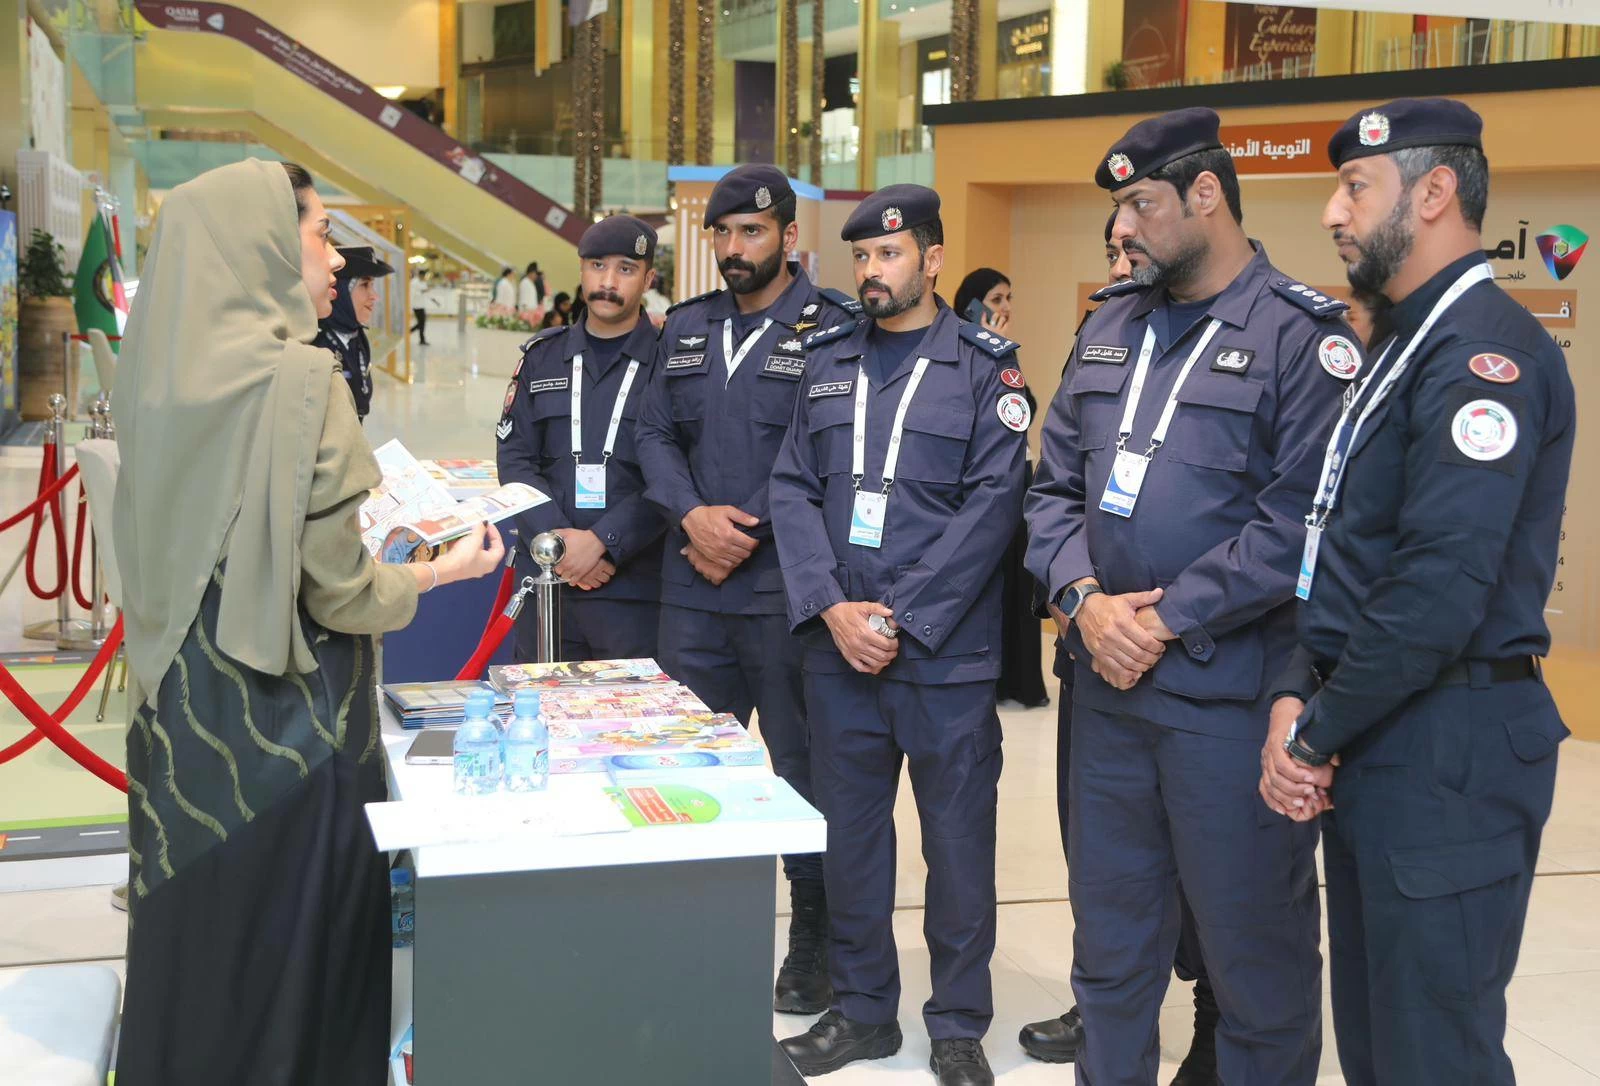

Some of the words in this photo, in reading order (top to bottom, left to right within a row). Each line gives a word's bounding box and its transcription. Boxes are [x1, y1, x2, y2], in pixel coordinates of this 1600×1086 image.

[1221, 138, 1260, 157] الأمن
[1262, 138, 1311, 160] التوعية
[1485, 219, 1529, 260] آم
